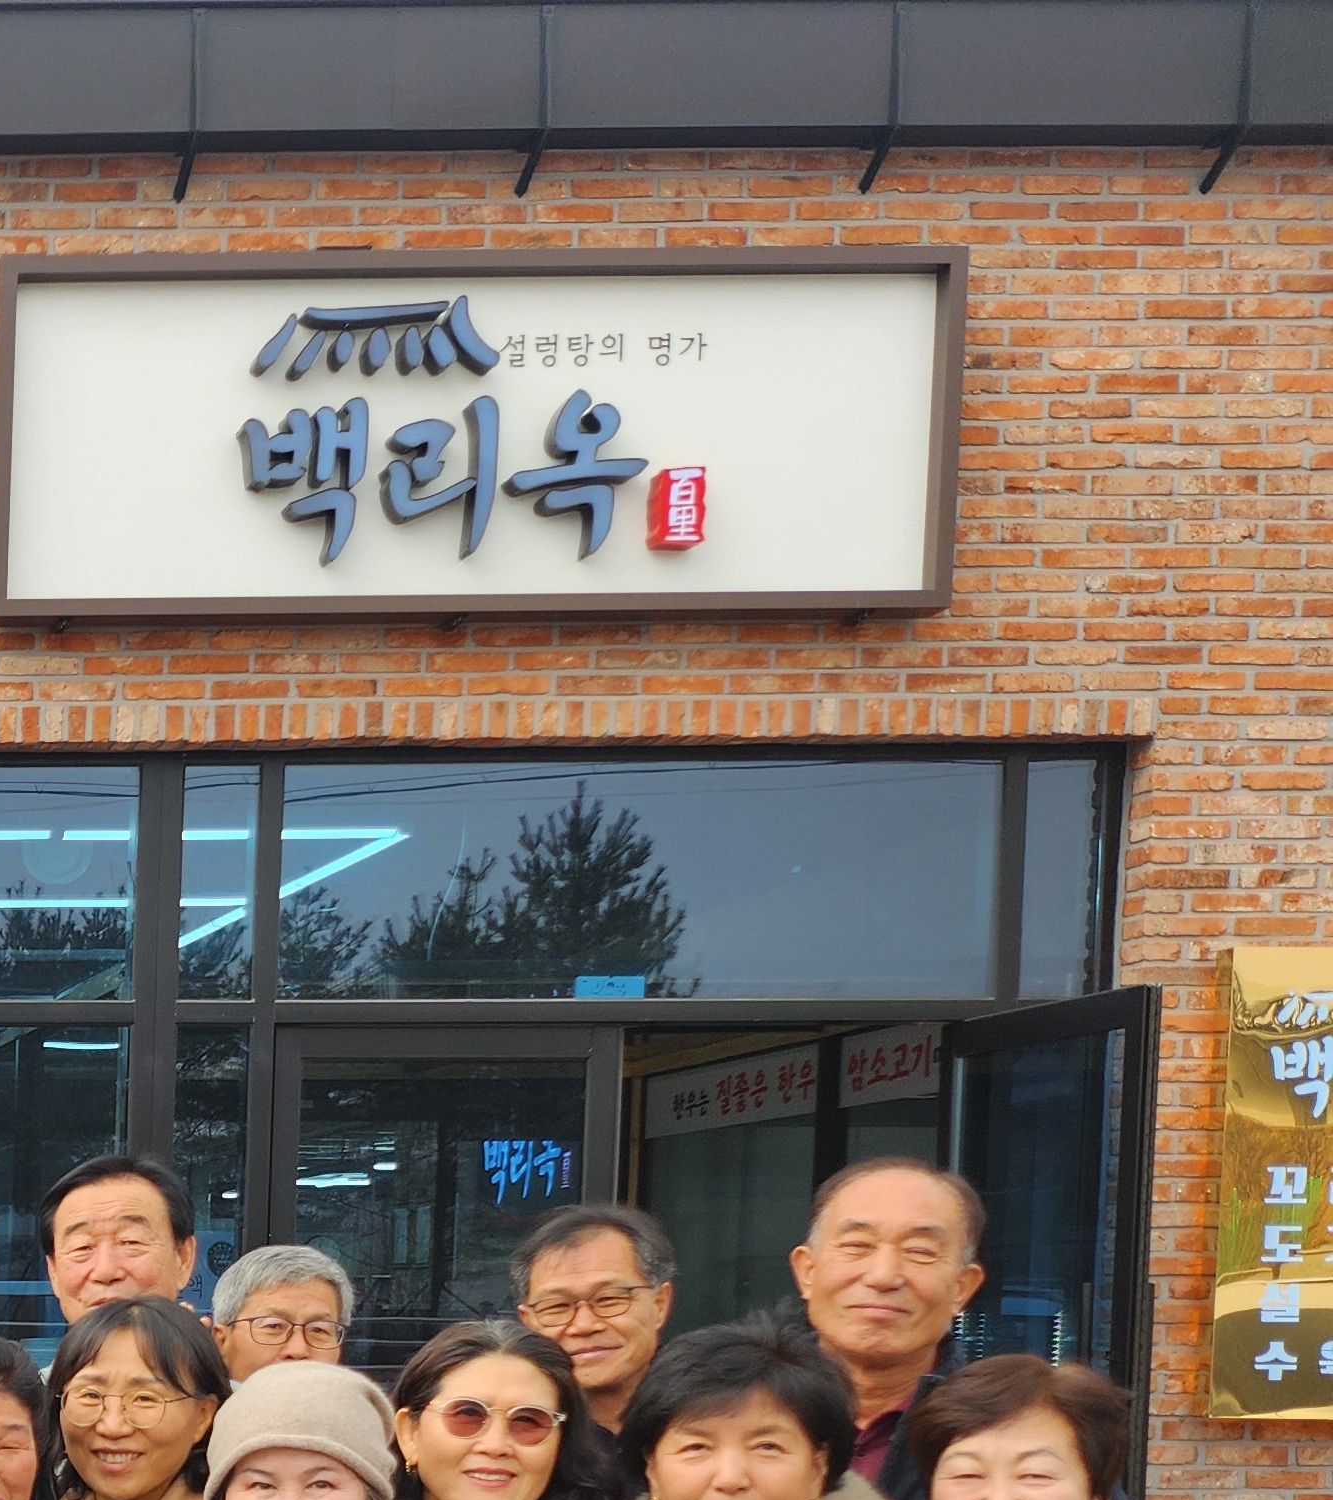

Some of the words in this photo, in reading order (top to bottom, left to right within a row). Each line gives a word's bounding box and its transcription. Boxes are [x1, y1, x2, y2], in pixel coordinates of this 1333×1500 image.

[499, 332, 625, 366] 설렁탕의
[646, 331, 710, 364] 명가
[235, 387, 649, 568] 백리옥
